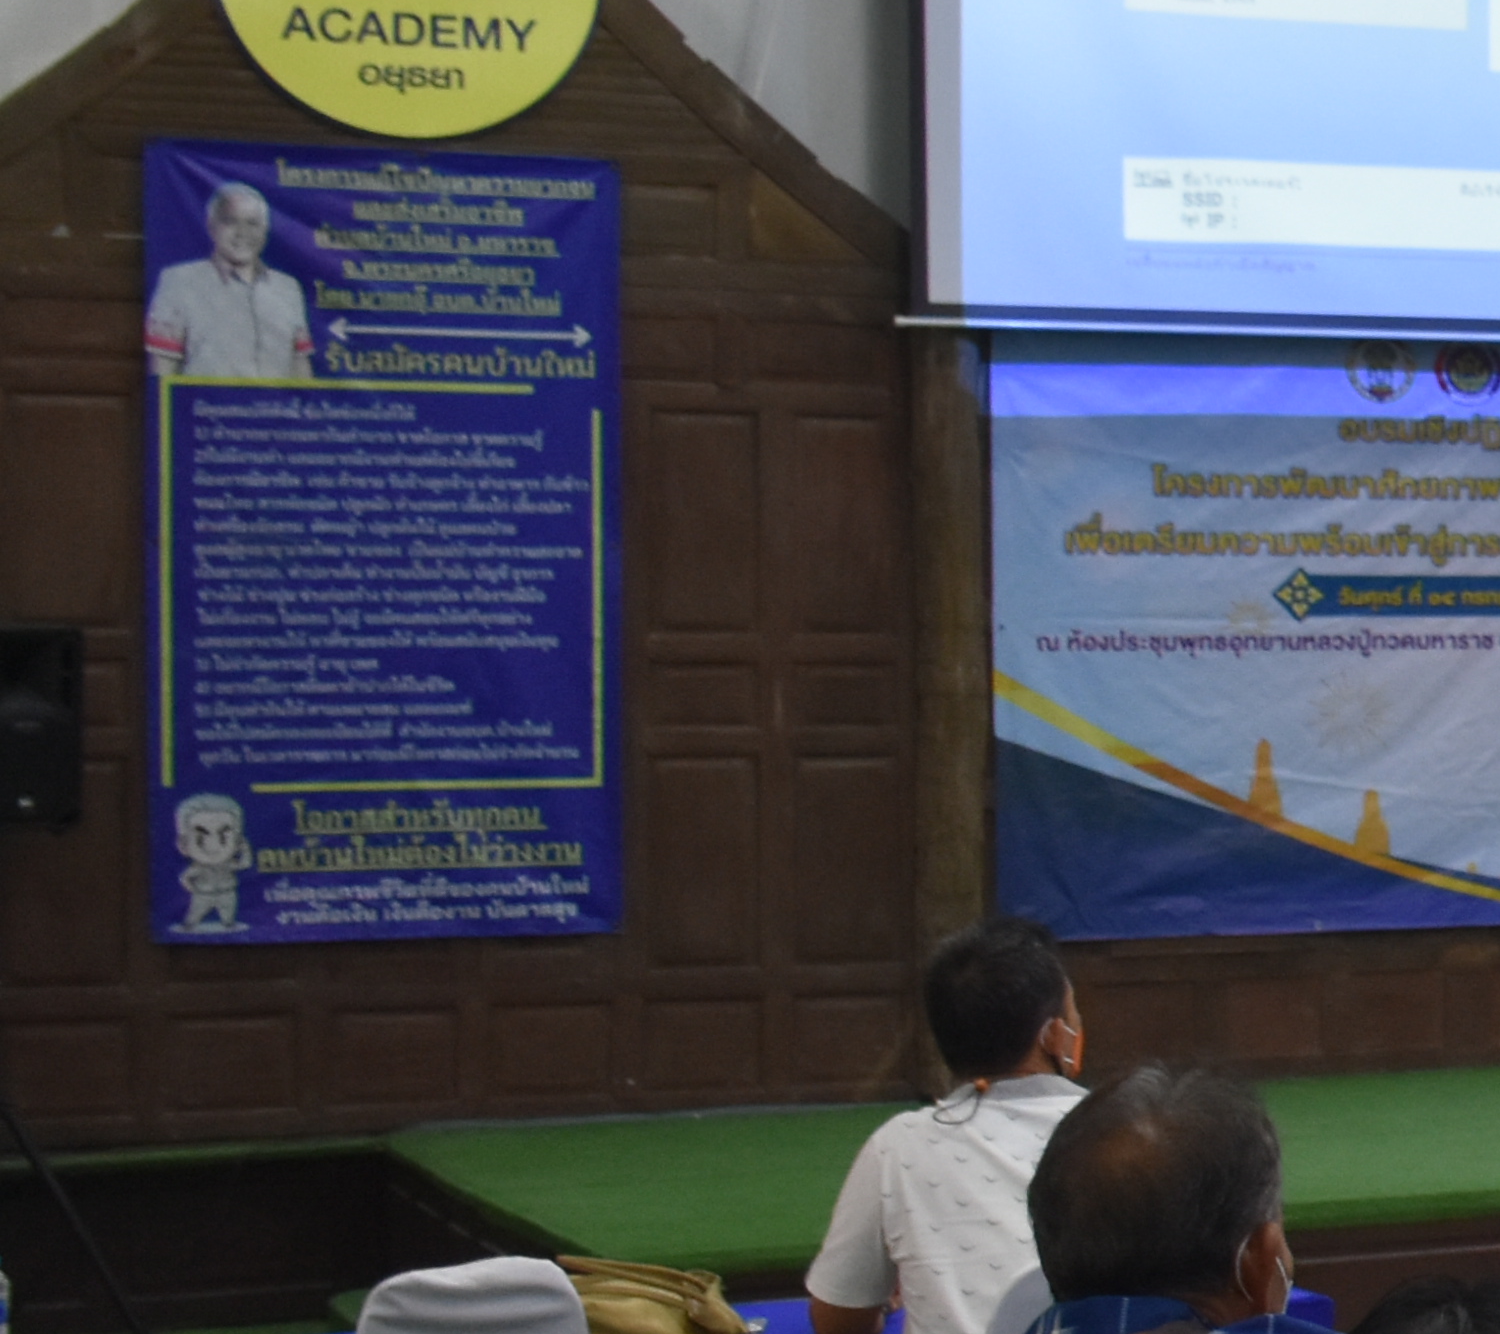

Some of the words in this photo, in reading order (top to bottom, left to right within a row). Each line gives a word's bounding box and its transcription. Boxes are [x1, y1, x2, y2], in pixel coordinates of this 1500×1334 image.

[280, 6, 538, 53] ACADEMY
[358, 62, 466, 96] อยุธยา
[325, 341, 597, 379] รับสมัครคนบ้านใหม่
[1339, 584, 1404, 612] วันศุกร์
[1036, 634, 1060, 653] ณ
